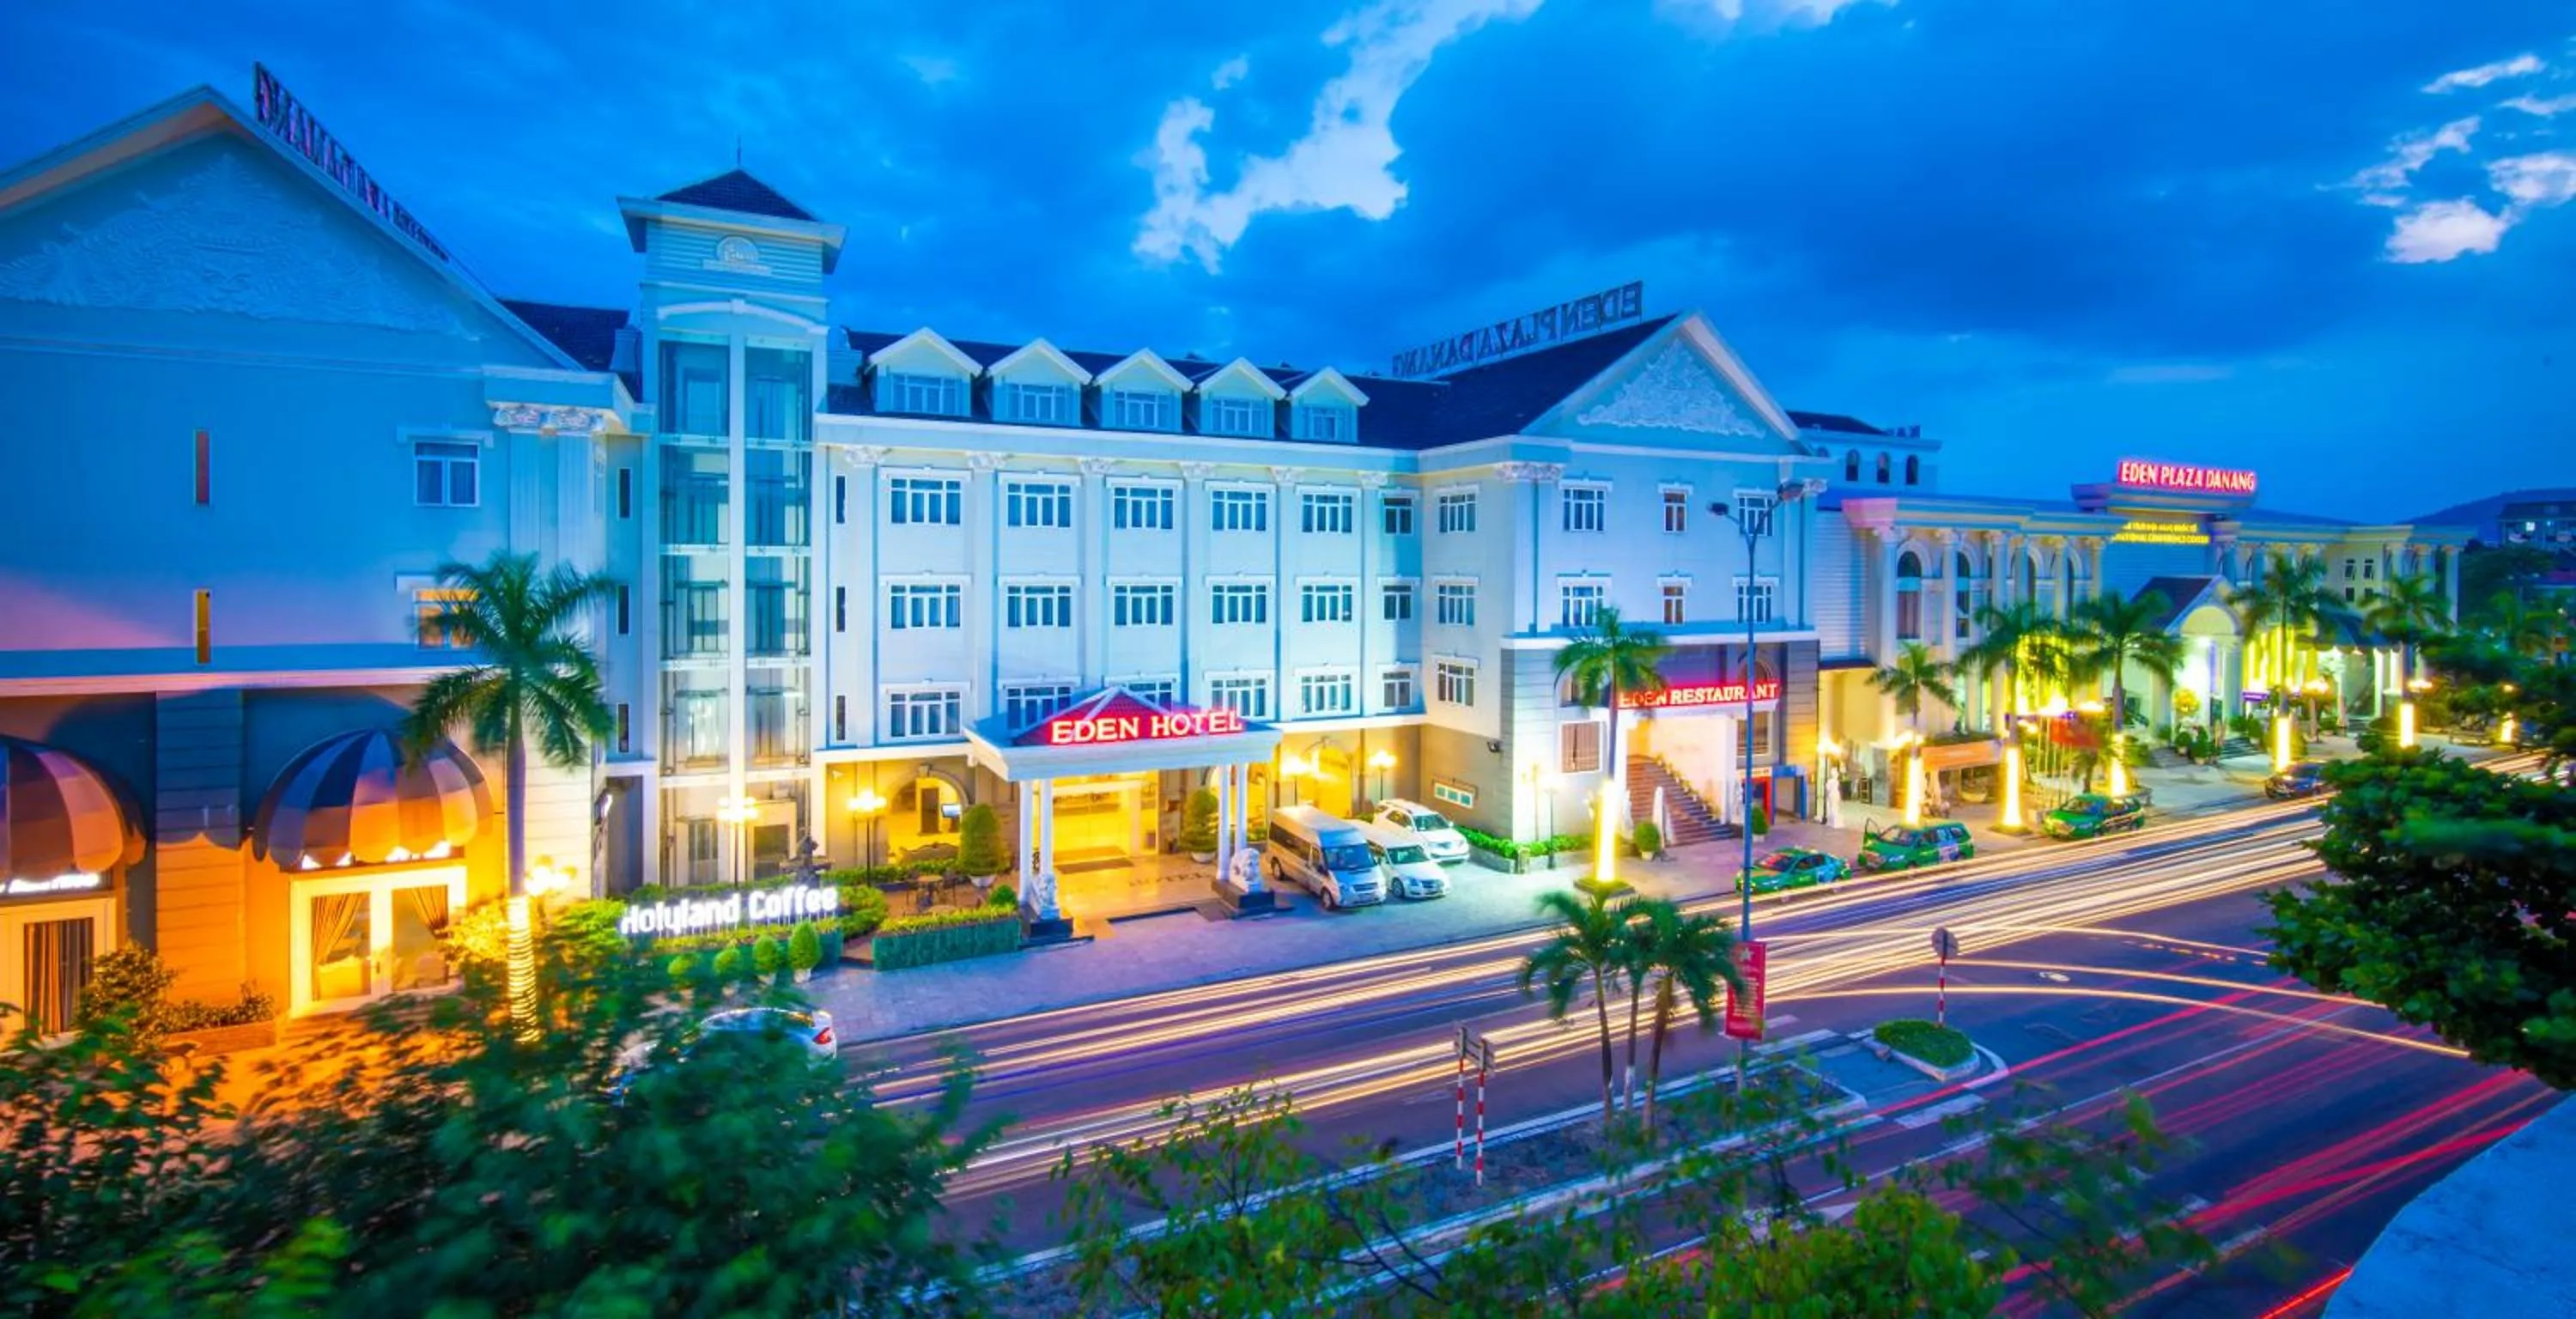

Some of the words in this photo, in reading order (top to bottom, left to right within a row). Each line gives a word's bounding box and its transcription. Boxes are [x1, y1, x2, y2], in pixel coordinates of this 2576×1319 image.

[2121, 462, 2157, 484] EDEN
[2160, 465, 2202, 488] PLAZA
[2206, 470, 2256, 491] DANANG
[1618, 690, 1667, 707] EDEN
[1051, 715, 1140, 744] EDEN
[1151, 710, 1243, 737] HOTEL
[621, 892, 741, 935] Holyland
[748, 884, 838, 920] Coffee
